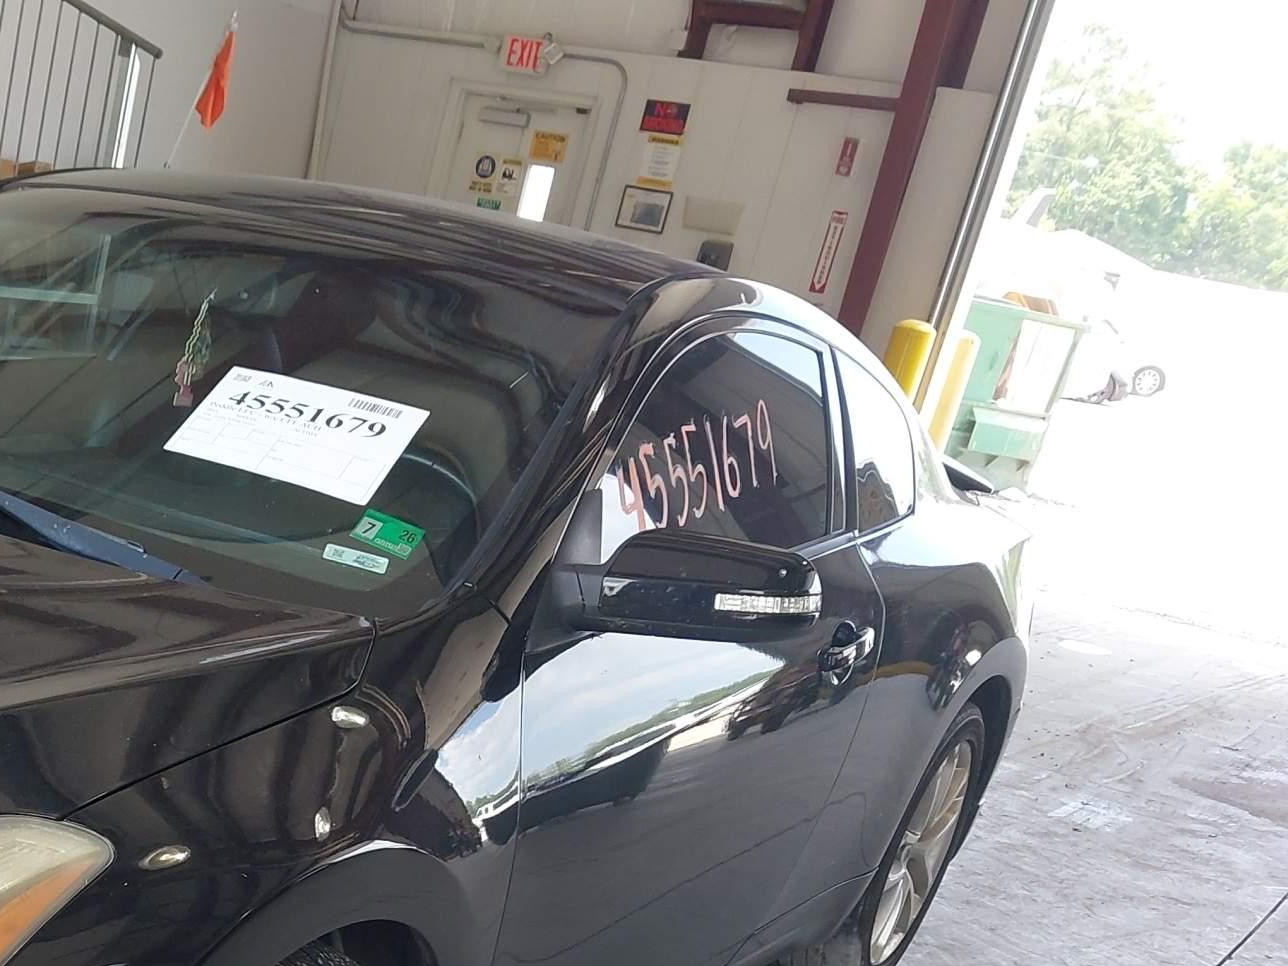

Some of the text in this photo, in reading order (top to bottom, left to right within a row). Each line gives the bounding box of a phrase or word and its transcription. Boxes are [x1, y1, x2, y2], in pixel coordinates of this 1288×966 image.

[505, 38, 543, 72] EXIT
[228, 391, 387, 437] 45551679
[616, 399, 778, 531] 45551679
[362, 521, 376, 534] 7
[399, 529, 417, 544] 26
